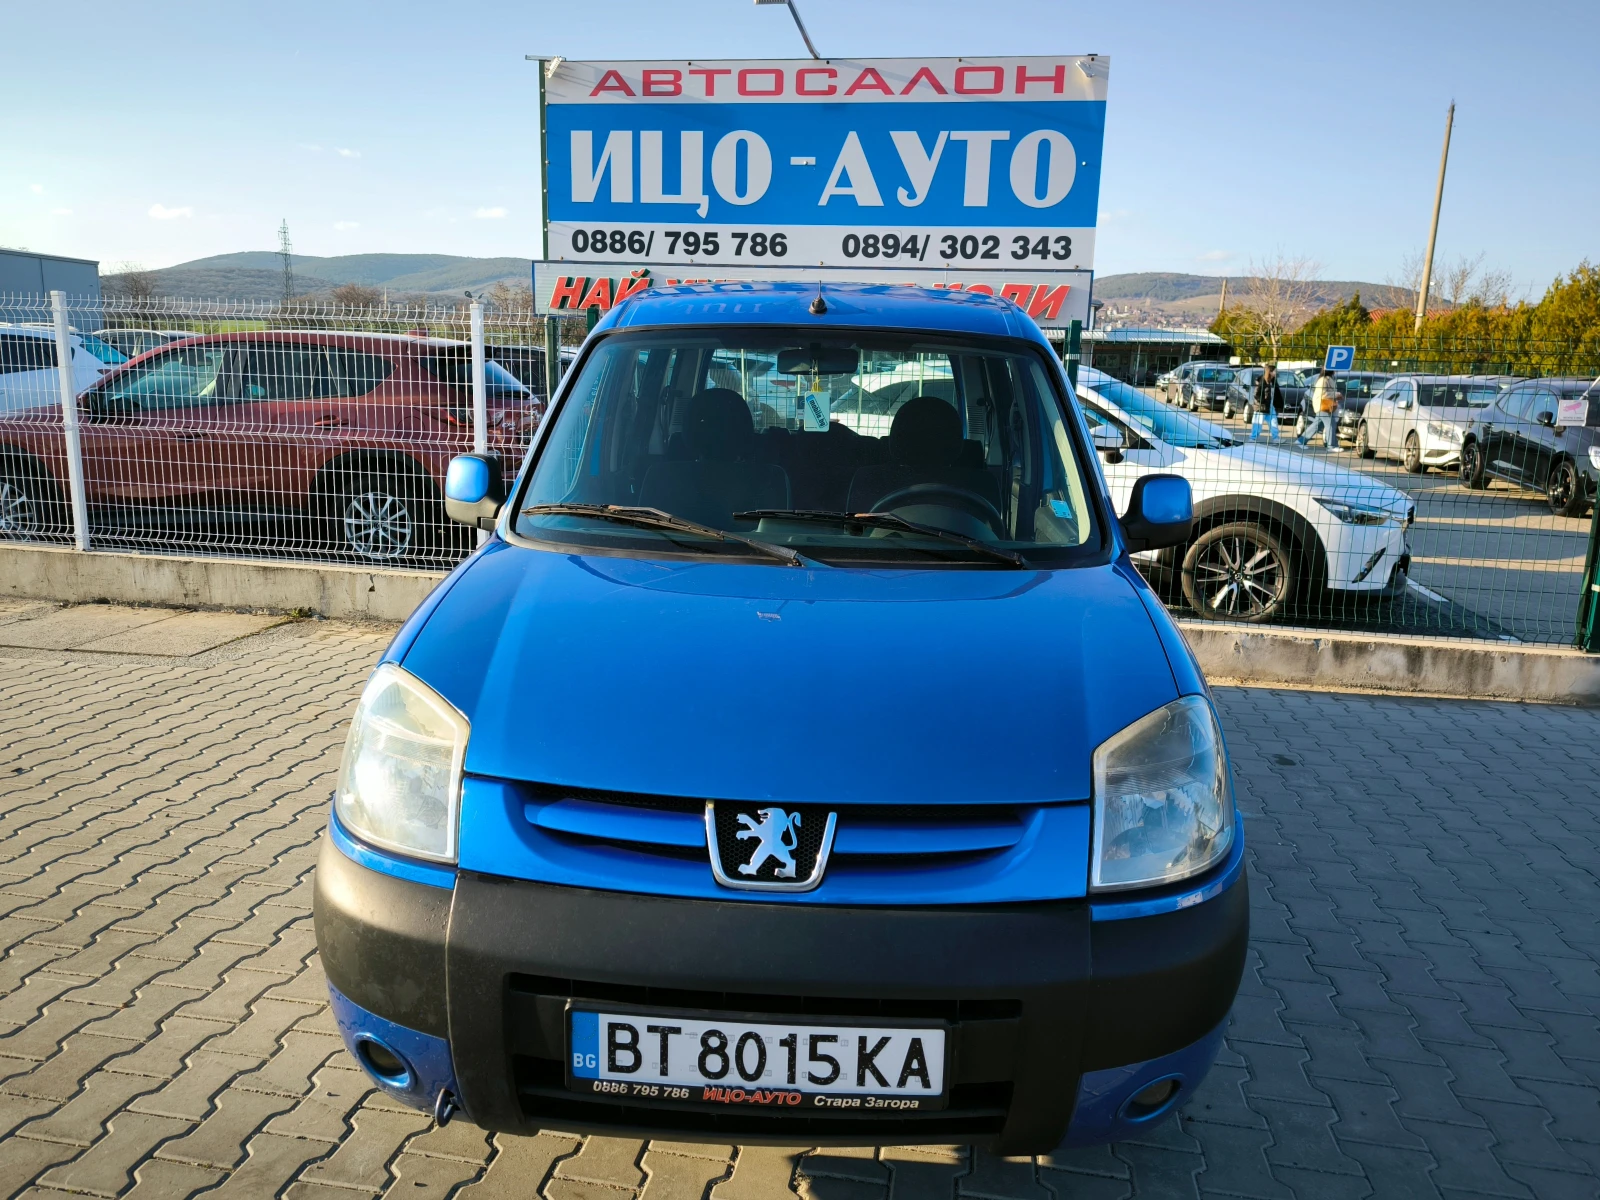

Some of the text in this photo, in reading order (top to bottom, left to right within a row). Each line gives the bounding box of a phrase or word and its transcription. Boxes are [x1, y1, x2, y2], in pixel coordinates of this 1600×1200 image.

[589, 65, 1066, 97] АВТОСАЛОН
[570, 229, 788, 259] 0886/ 795 786
[841, 233, 1072, 262] 0894/ 302 343
[1330, 348, 1349, 368] P
[572, 1052, 597, 1070] BG
[606, 1021, 932, 1089] BT 8015 KA
[593, 1081, 628, 1094] 0886
[632, 1084, 659, 1096] 795
[663, 1086, 690, 1099] 786
[814, 1095, 861, 1108] Стара
[864, 1096, 919, 1110] Загора
